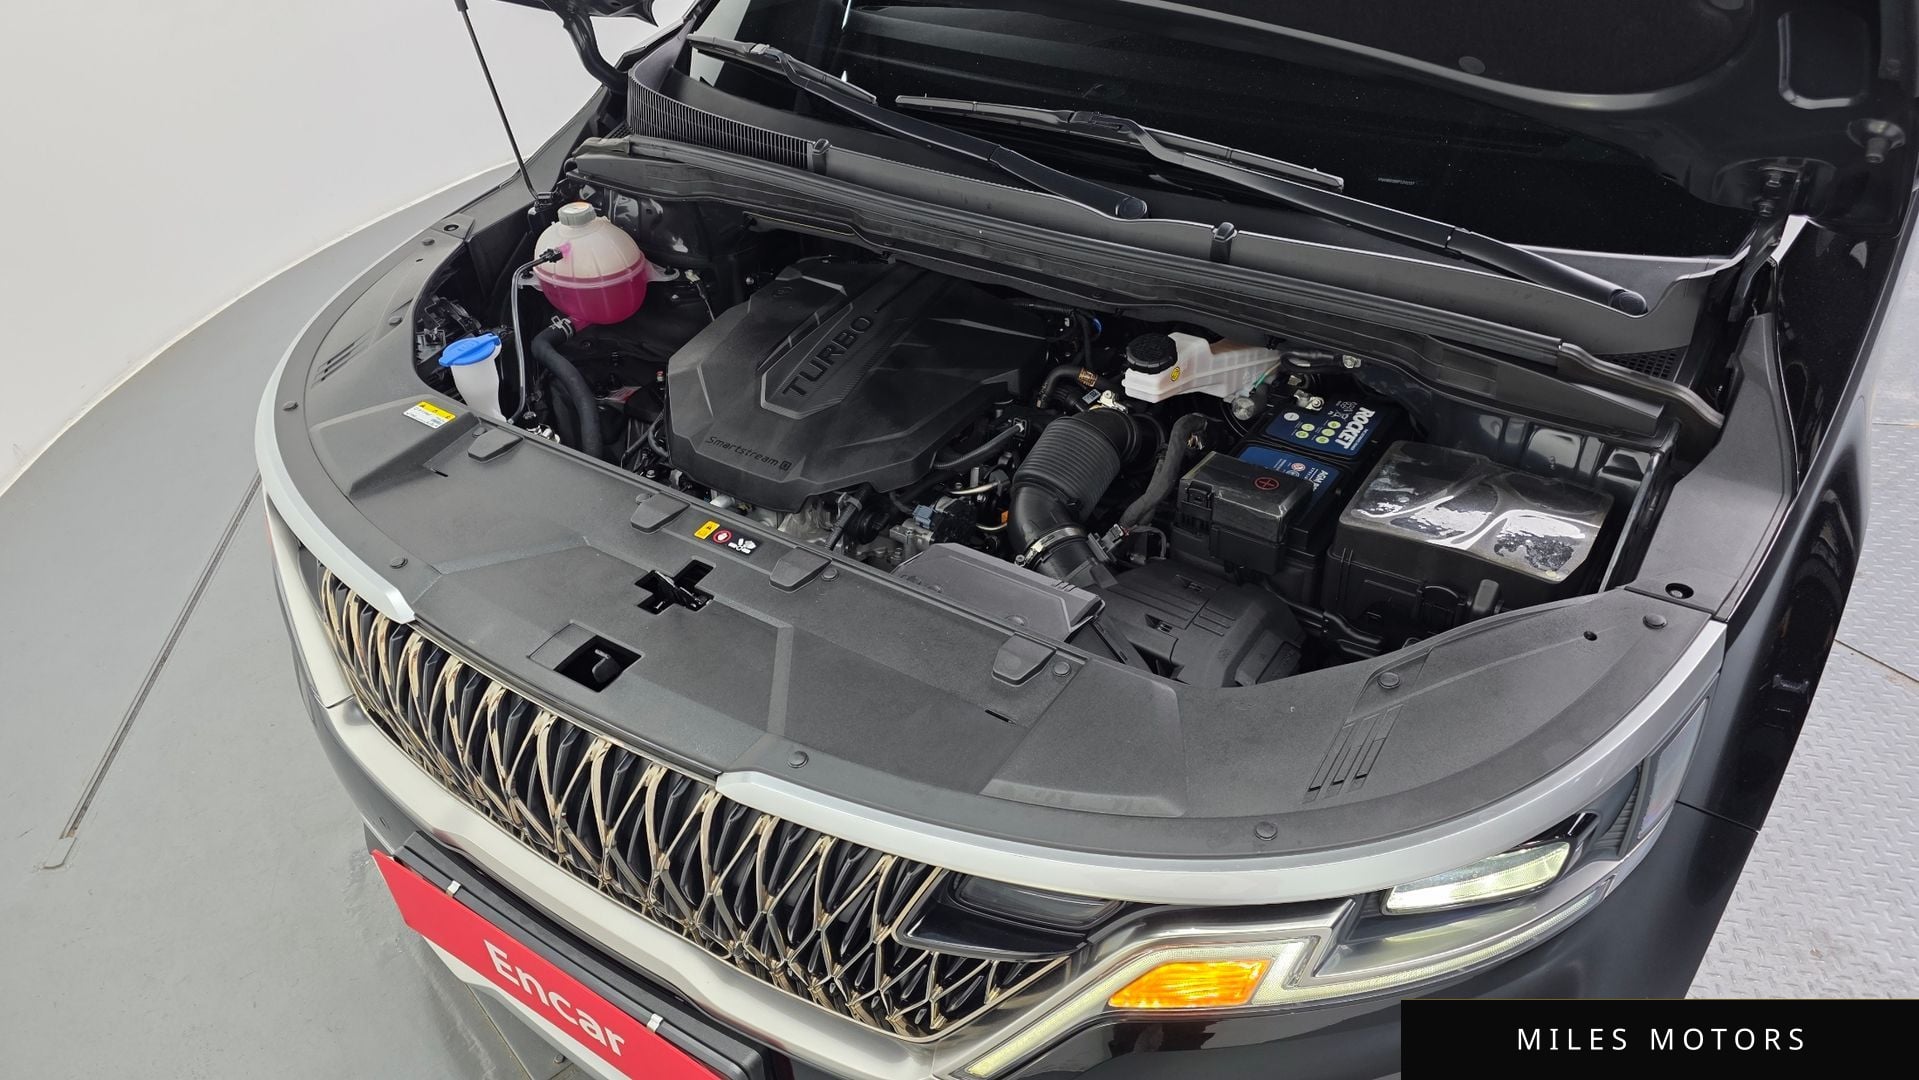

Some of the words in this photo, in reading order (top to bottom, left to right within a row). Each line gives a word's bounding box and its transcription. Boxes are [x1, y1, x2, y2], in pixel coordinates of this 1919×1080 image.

[782, 316, 874, 396] TURBO
[706, 436, 779, 466] Smartstream
[1335, 407, 1375, 449] ROCKET
[484, 939, 625, 1056] Encar
